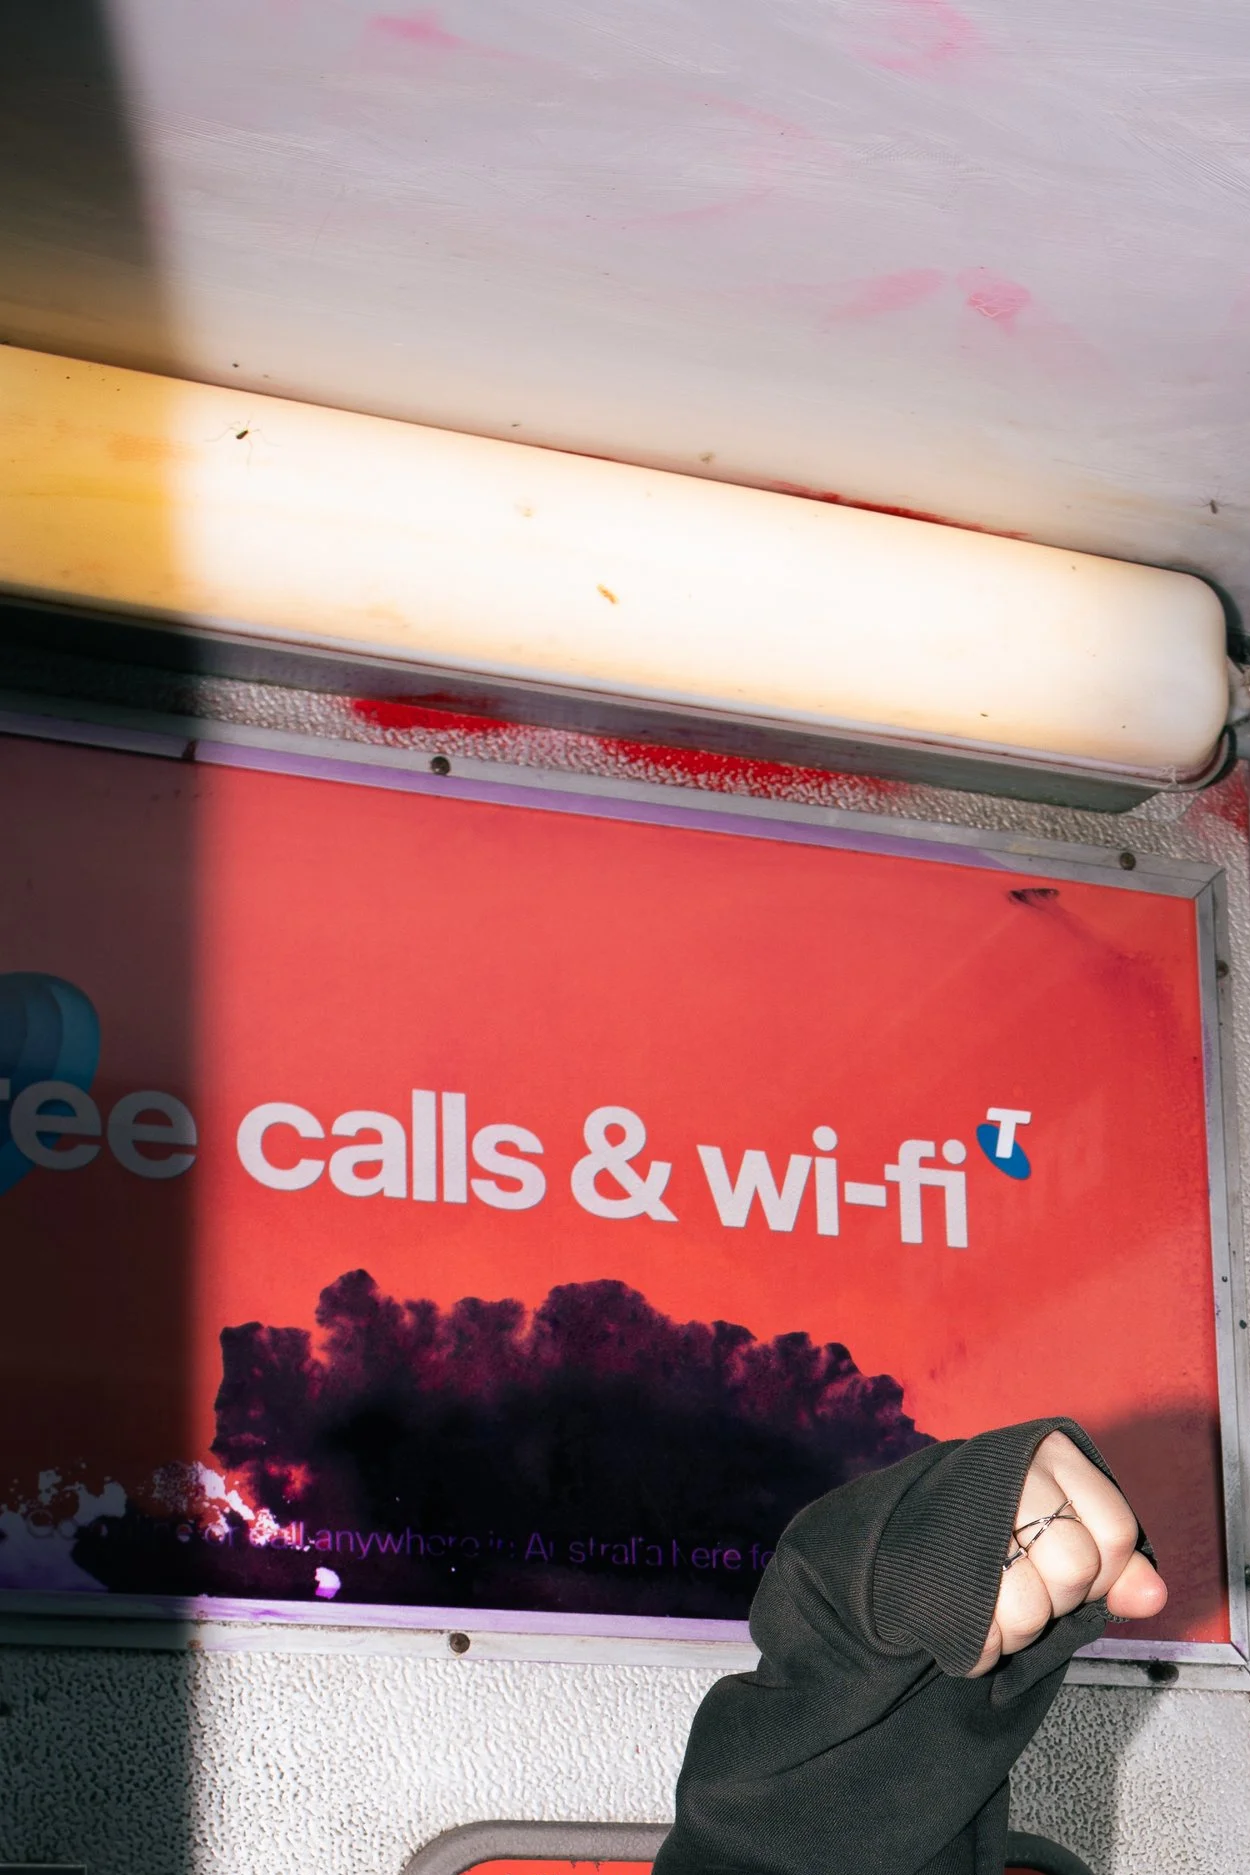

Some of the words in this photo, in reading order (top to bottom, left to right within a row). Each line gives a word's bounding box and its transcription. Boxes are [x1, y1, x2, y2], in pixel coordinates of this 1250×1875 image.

[0, 1077, 198, 1180] ee
[235, 1089, 547, 1211] calls
[570, 1104, 678, 1222] &
[696, 1125, 968, 1248] wi-fi
